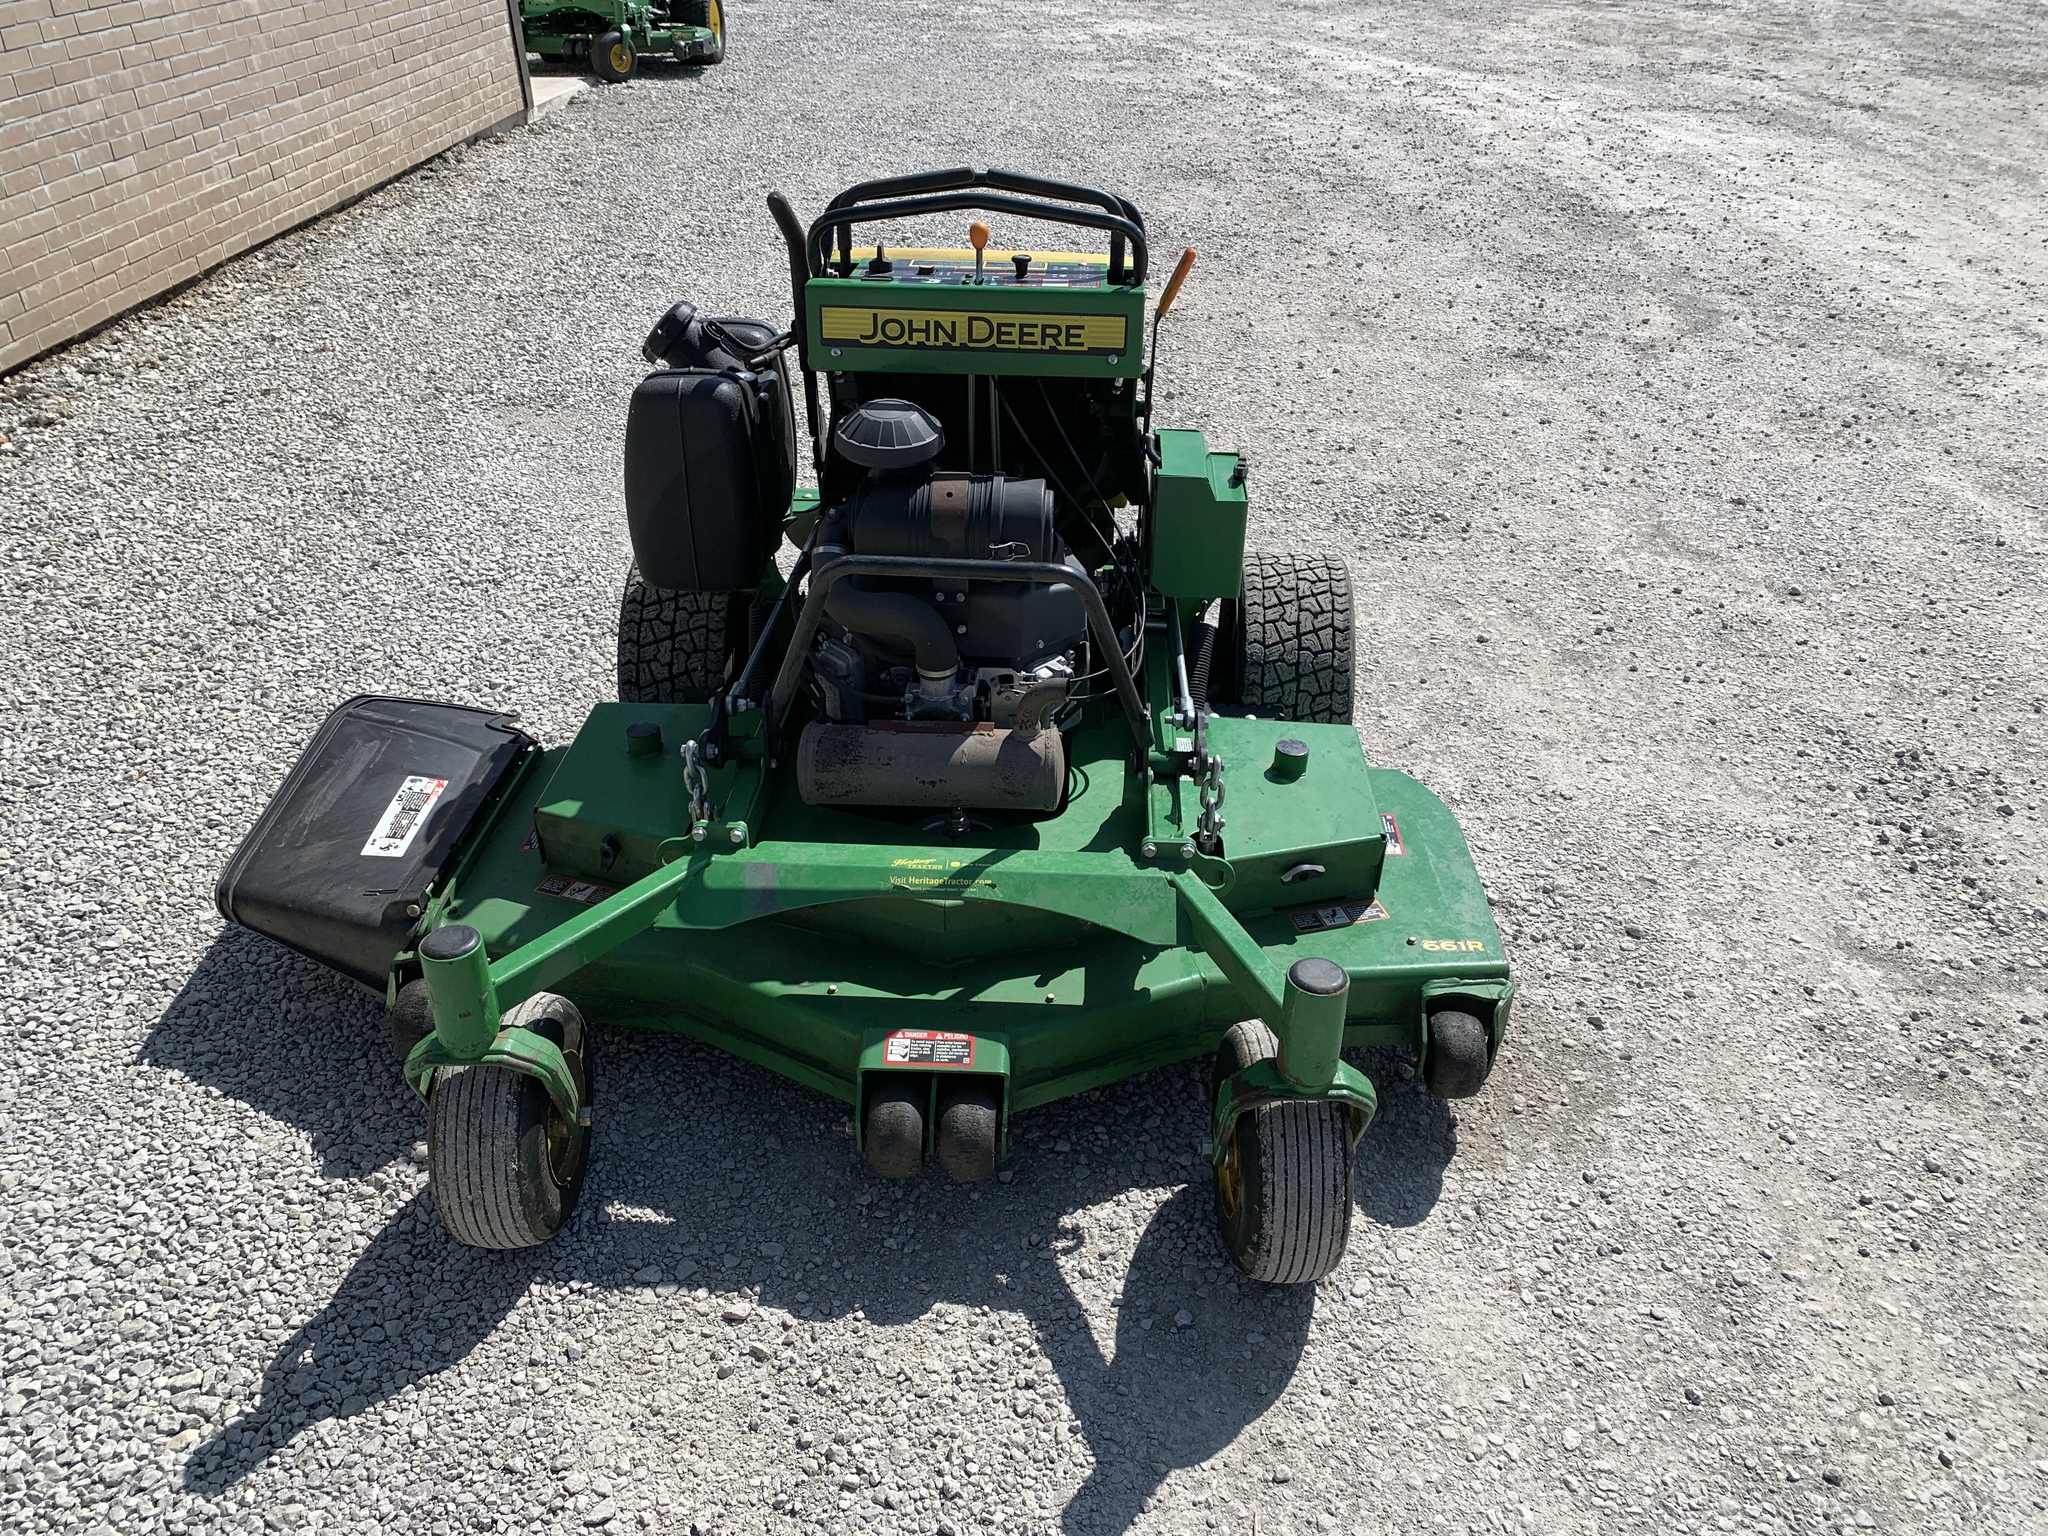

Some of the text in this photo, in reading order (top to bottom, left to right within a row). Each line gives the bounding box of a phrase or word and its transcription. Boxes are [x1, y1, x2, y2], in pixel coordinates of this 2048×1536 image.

[859, 311, 1086, 348] JOHN DEERE
[891, 859, 937, 867] Heritage
[890, 876, 992, 886] Visit HeritageTractorcom
[1420, 940, 1485, 952] 661R
